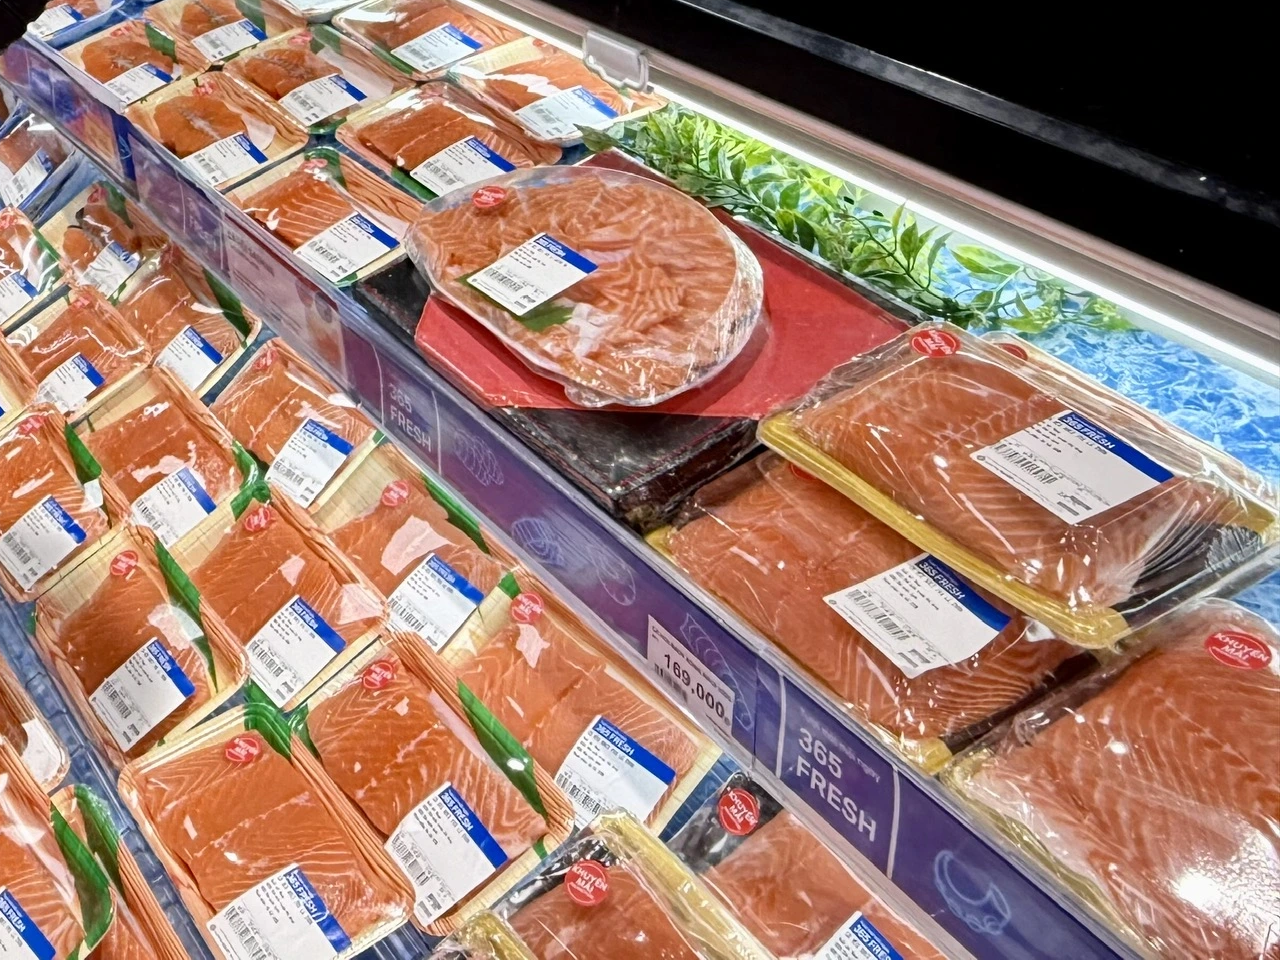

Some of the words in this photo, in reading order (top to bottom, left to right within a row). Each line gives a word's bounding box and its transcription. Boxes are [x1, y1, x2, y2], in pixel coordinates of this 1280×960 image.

[388, 382, 413, 414] 365
[390, 404, 432, 453] FRESH
[1081, 427, 1116, 449] FRESH
[934, 571, 966, 600] FRESH
[607, 733, 635, 756] FRESH
[798, 727, 843, 779] 365
[796, 755, 877, 842] FRESH
[451, 803, 474, 831] FRESH
